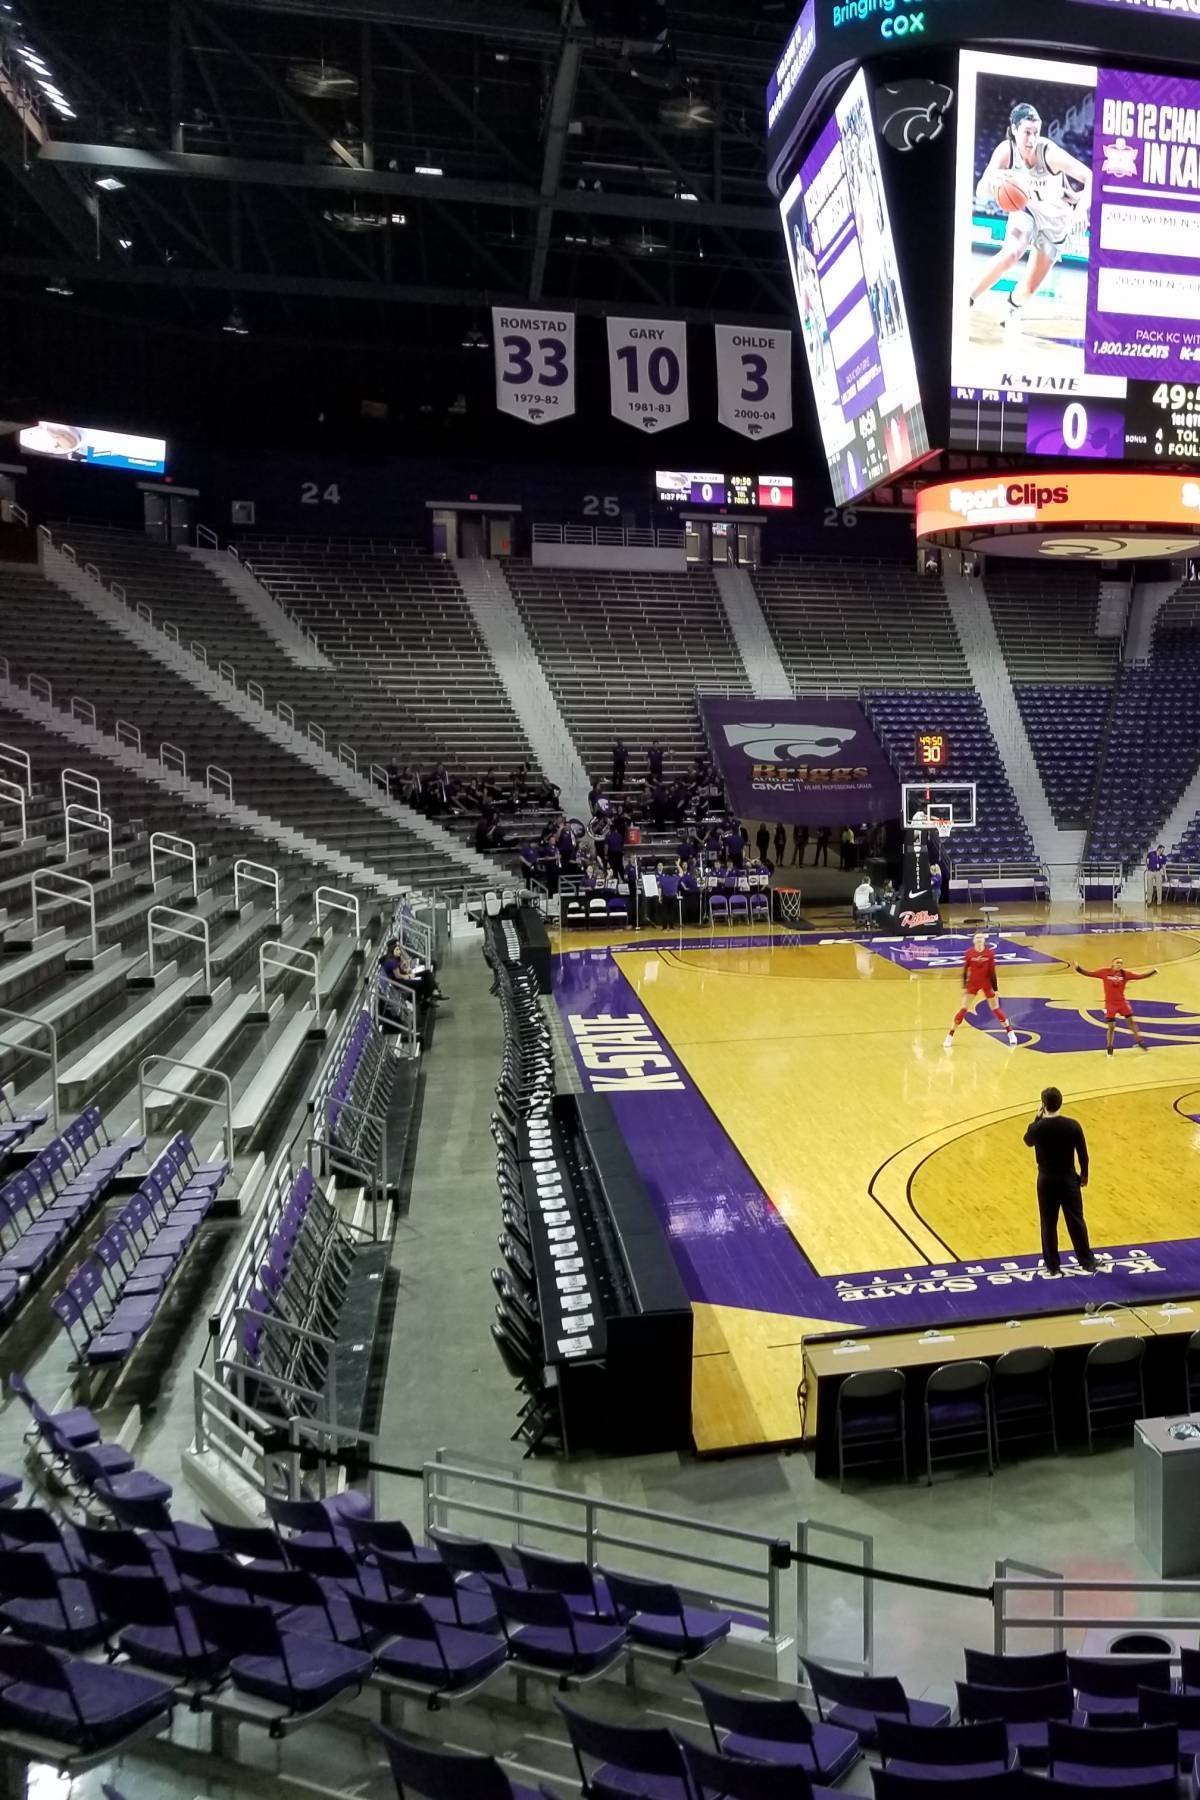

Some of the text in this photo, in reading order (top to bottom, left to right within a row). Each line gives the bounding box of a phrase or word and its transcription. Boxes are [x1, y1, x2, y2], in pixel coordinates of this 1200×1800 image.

[1102, 98, 1134, 136] BIG
[1137, 102, 1156, 138] 12
[1143, 141, 1162, 185] IN
[500, 316, 567, 333] ROMSTAD
[628, 328, 665, 341] GARY
[732, 335, 776, 349] OHLDE
[1136, 330, 1164, 342] PACK
[1166, 332, 1180, 344] KC
[502, 335, 569, 387] 33
[616, 345, 680, 395] 10
[740, 353, 769, 402] 3
[1001, 373, 1080, 391] K-STATE
[513, 393, 560, 405] 1979-82
[628, 401, 671, 413] 1981-83
[734, 409, 776, 421] 2000-04
[1062, 403, 1088, 449] 0
[1126, 434, 1147, 444] BONUS
[1155, 429, 1163, 440] 4
[1176, 429, 1199, 442] TOL
[1154, 443, 1162, 455] 0
[301, 482, 341, 504] 24
[702, 484, 781, 504] 0 0
[583, 495, 621, 517] 25
[823, 507, 857, 528] 26
[919, 736, 942, 747] 49:50
[923, 747, 940, 763] 30
[752, 764, 868, 781] Briggs
[752, 783, 794, 791] GMC
[567, 1013, 686, 1092] K-STATE
[835, 1249, 1149, 1290] UNIERSITY
[841, 1277, 978, 1302] STATE
